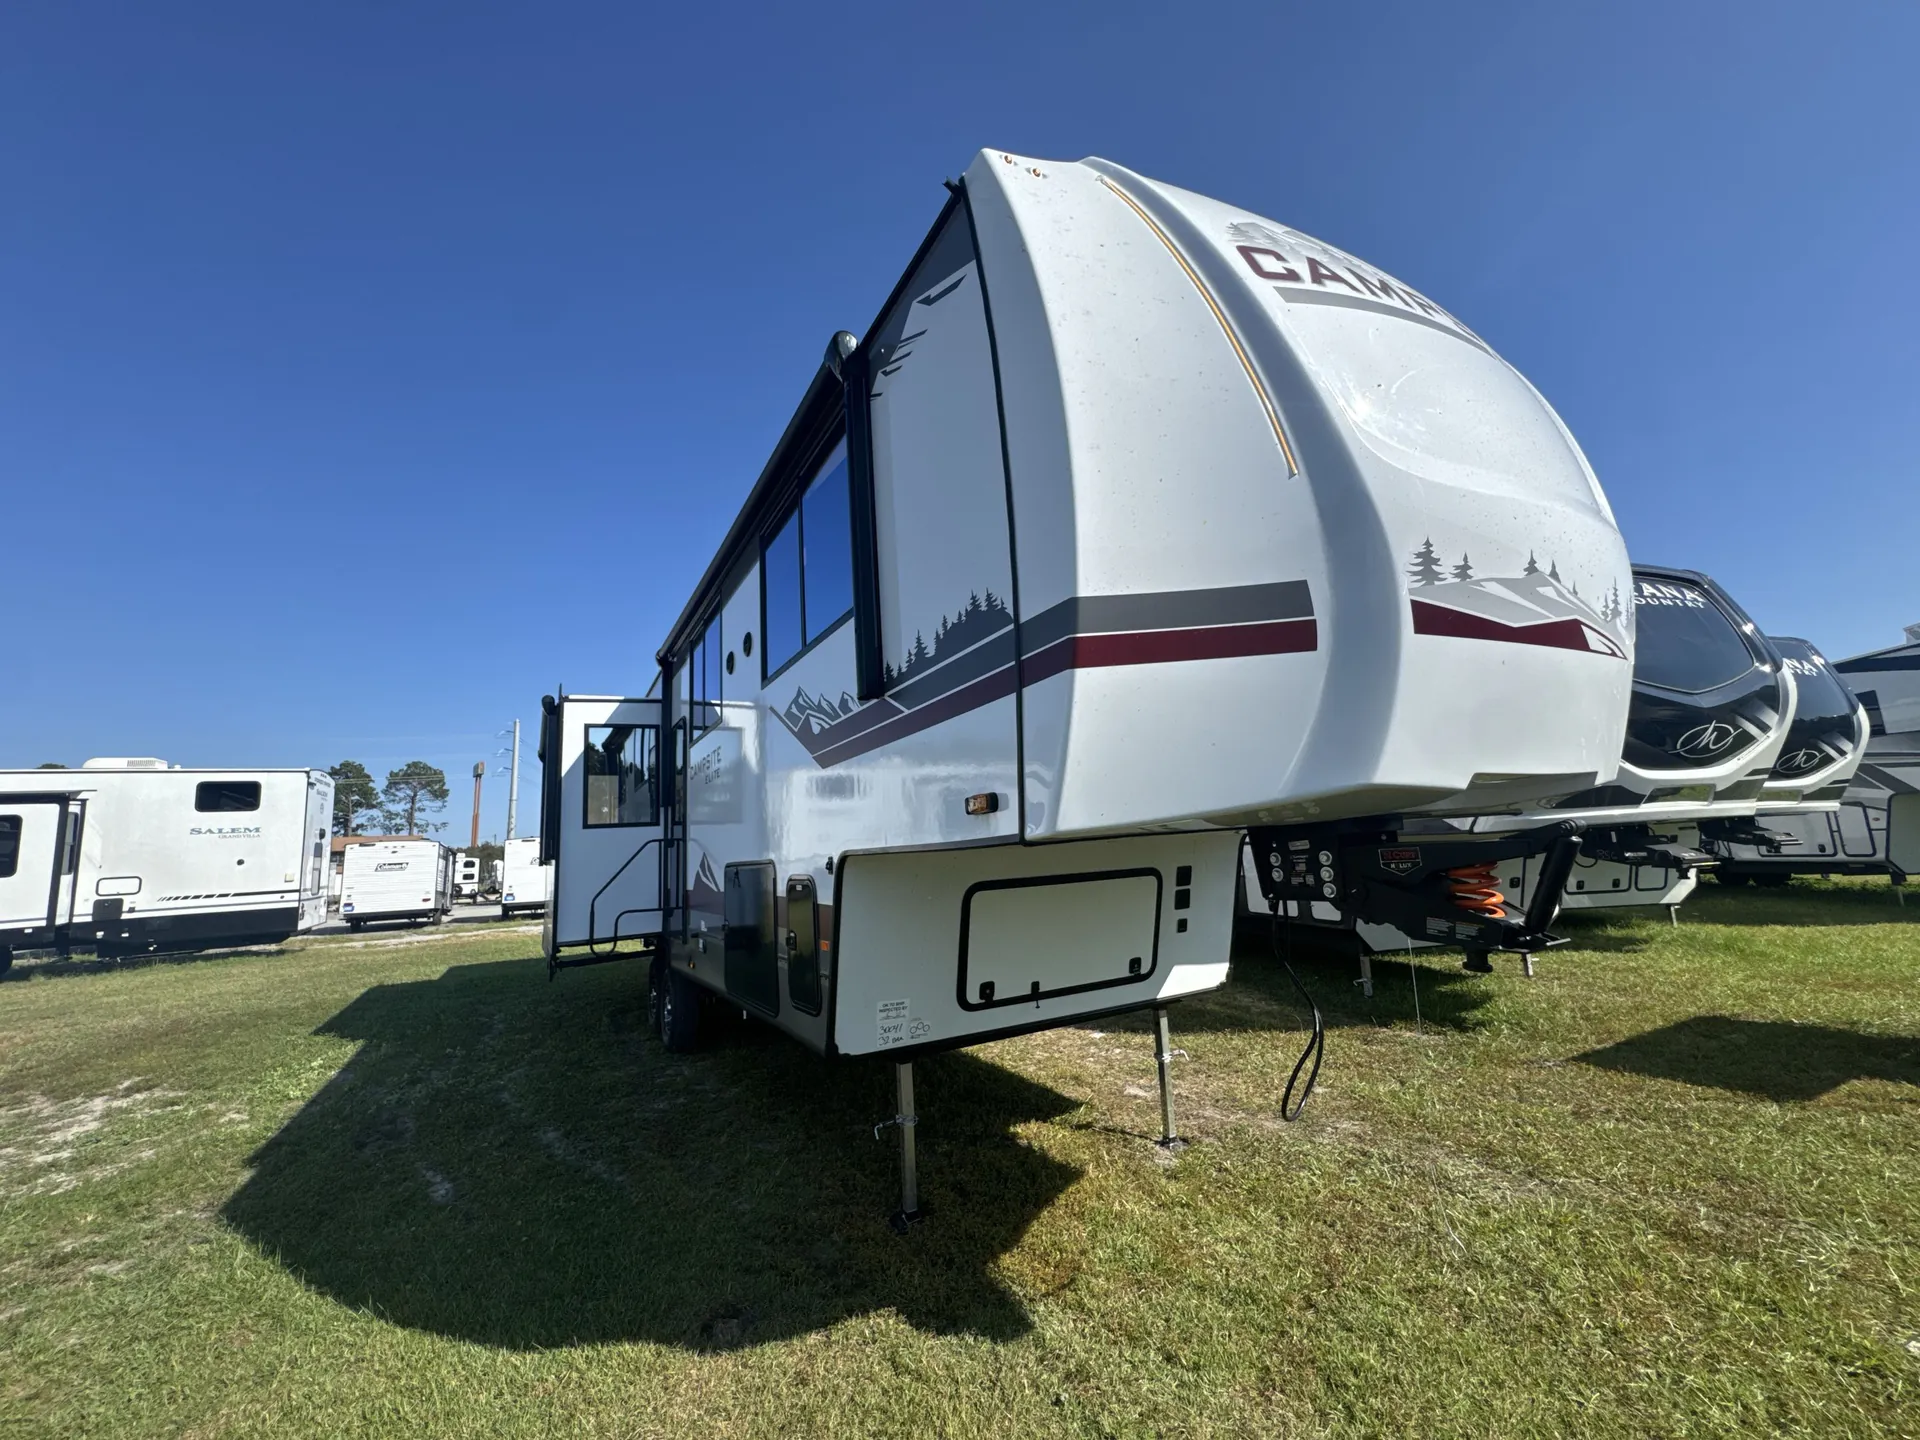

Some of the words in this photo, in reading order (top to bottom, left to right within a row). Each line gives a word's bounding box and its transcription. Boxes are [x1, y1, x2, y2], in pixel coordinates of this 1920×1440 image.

[1236, 245, 1480, 342] CAMP
[1633, 582, 1706, 603] ANA
[690, 745, 721, 781] CAMPSITE
[705, 767, 721, 785] ELITE
[189, 827, 261, 835] SALEM
